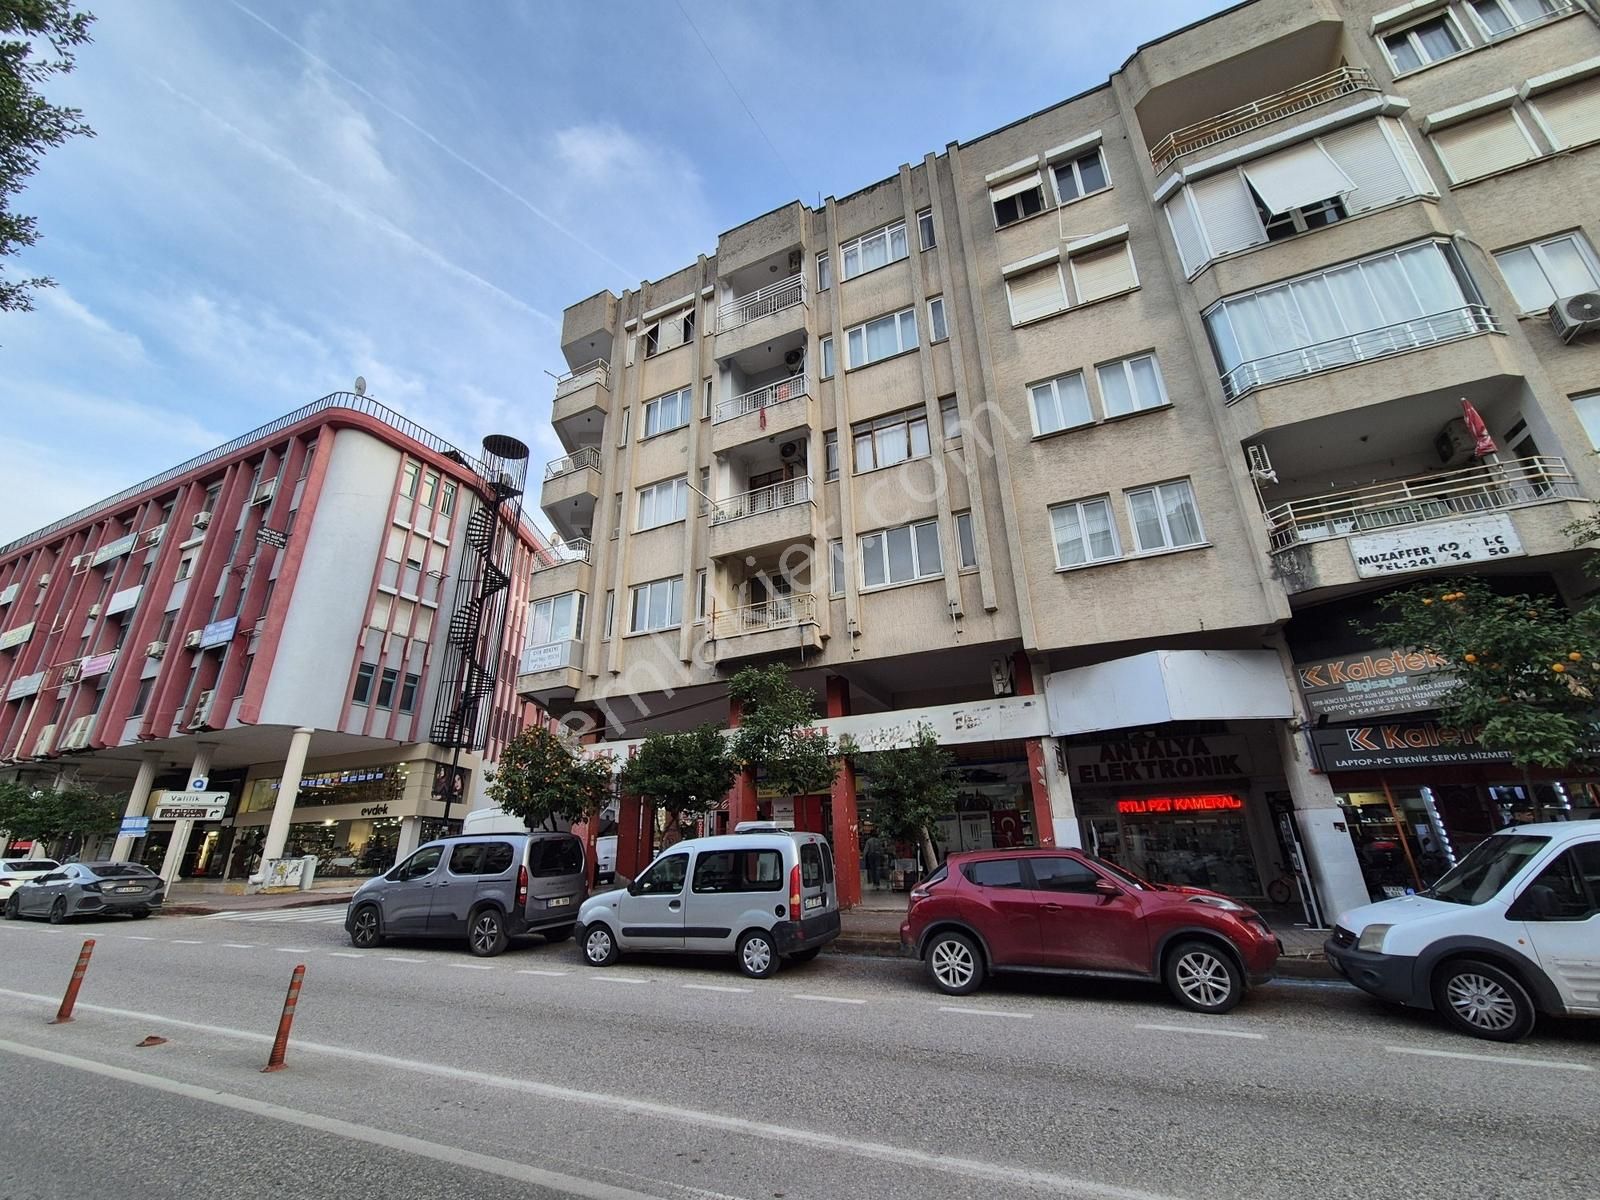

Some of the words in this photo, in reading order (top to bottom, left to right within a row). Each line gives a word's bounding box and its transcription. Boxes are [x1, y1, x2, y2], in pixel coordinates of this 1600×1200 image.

[1358, 546, 1431, 566] MUZAFFER
[1488, 546, 1510, 556] 50
[1327, 648, 1449, 684] Kaletek
[1345, 676, 1408, 693] Bilgisayar
[1100, 736, 1211, 763] ANTALYA
[1078, 754, 1243, 784] ELEKTRONIK
[1335, 757, 1392, 768] LAPTOP-PC
[1394, 754, 1430, 765] TEKNİK
[1432, 752, 1468, 762] SERVİS
[360, 803, 389, 816] evdek
